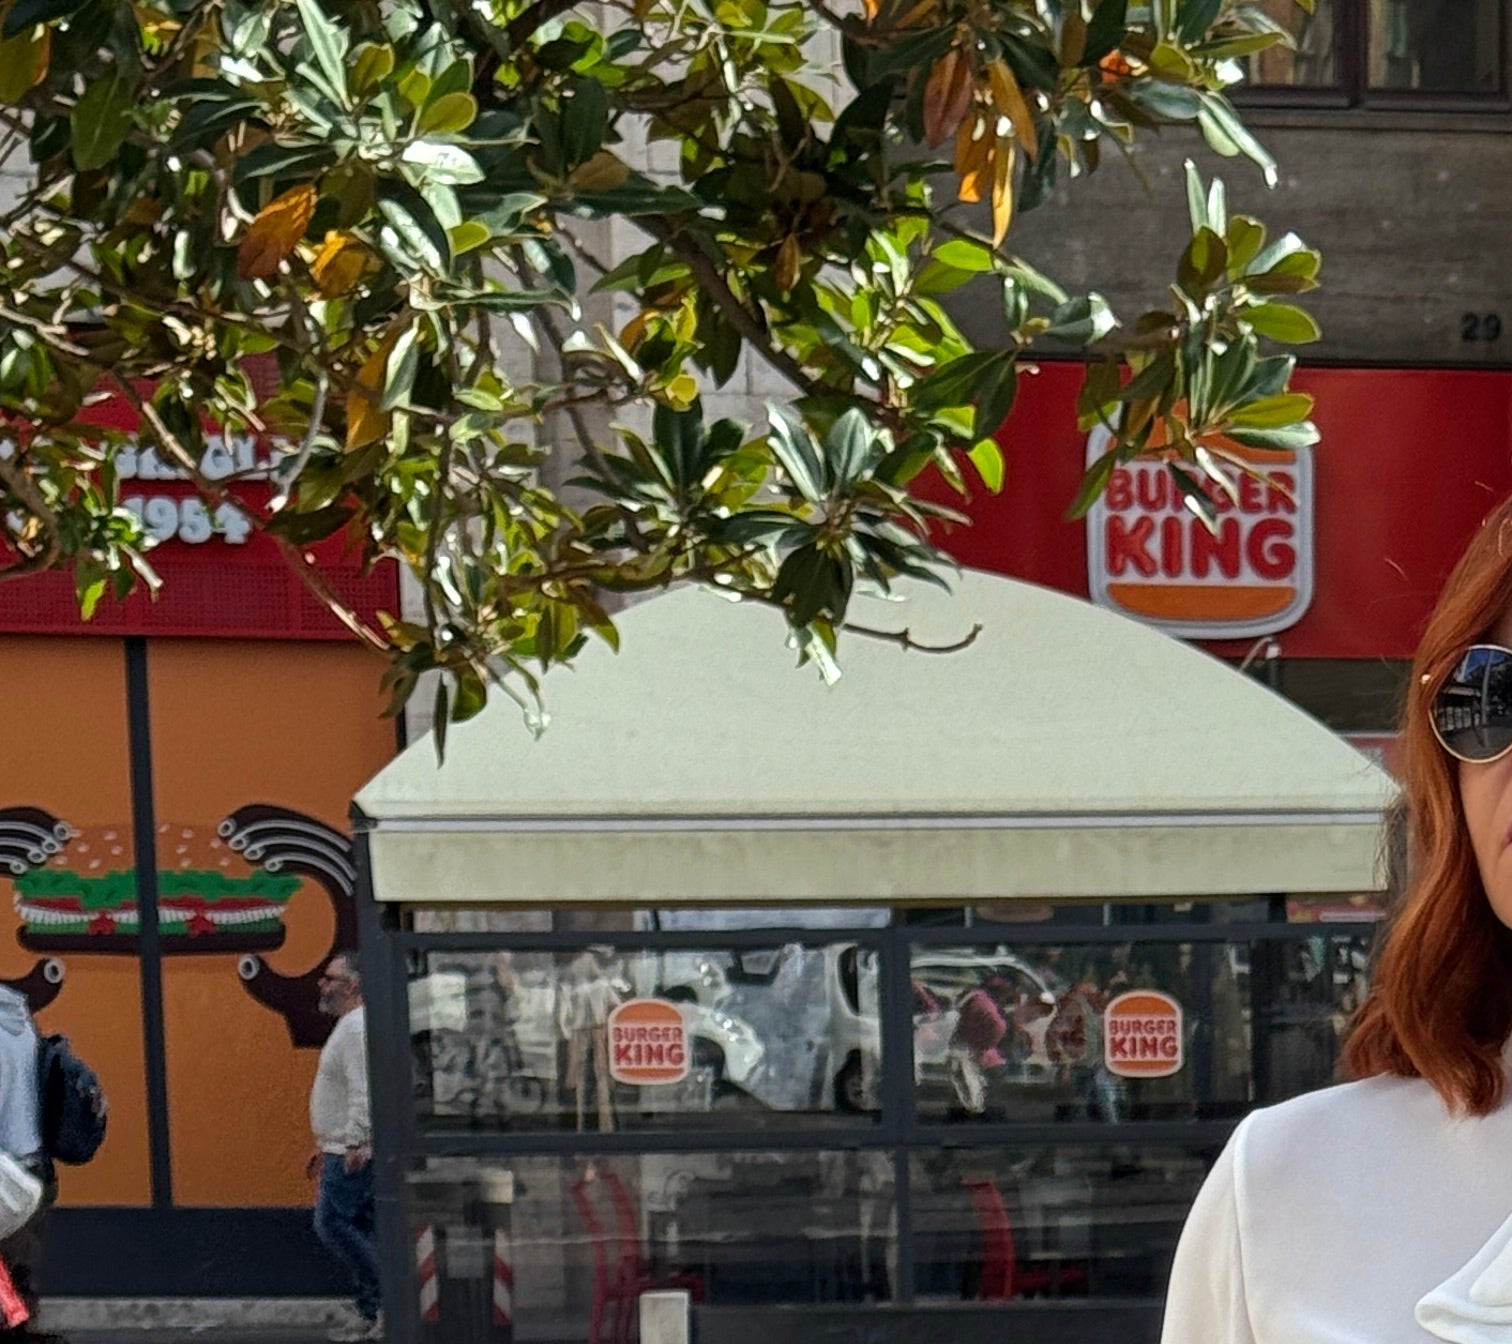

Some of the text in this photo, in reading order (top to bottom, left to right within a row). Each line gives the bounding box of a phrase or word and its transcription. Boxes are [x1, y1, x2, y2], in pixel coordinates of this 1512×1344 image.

[1462, 312, 1502, 341] 29
[1105, 514, 1296, 579] KING
[613, 1026, 682, 1043] BURGER
[1109, 1019, 1177, 1036] BURGER
[614, 1043, 684, 1066] KING
[1110, 1036, 1178, 1058] KING
